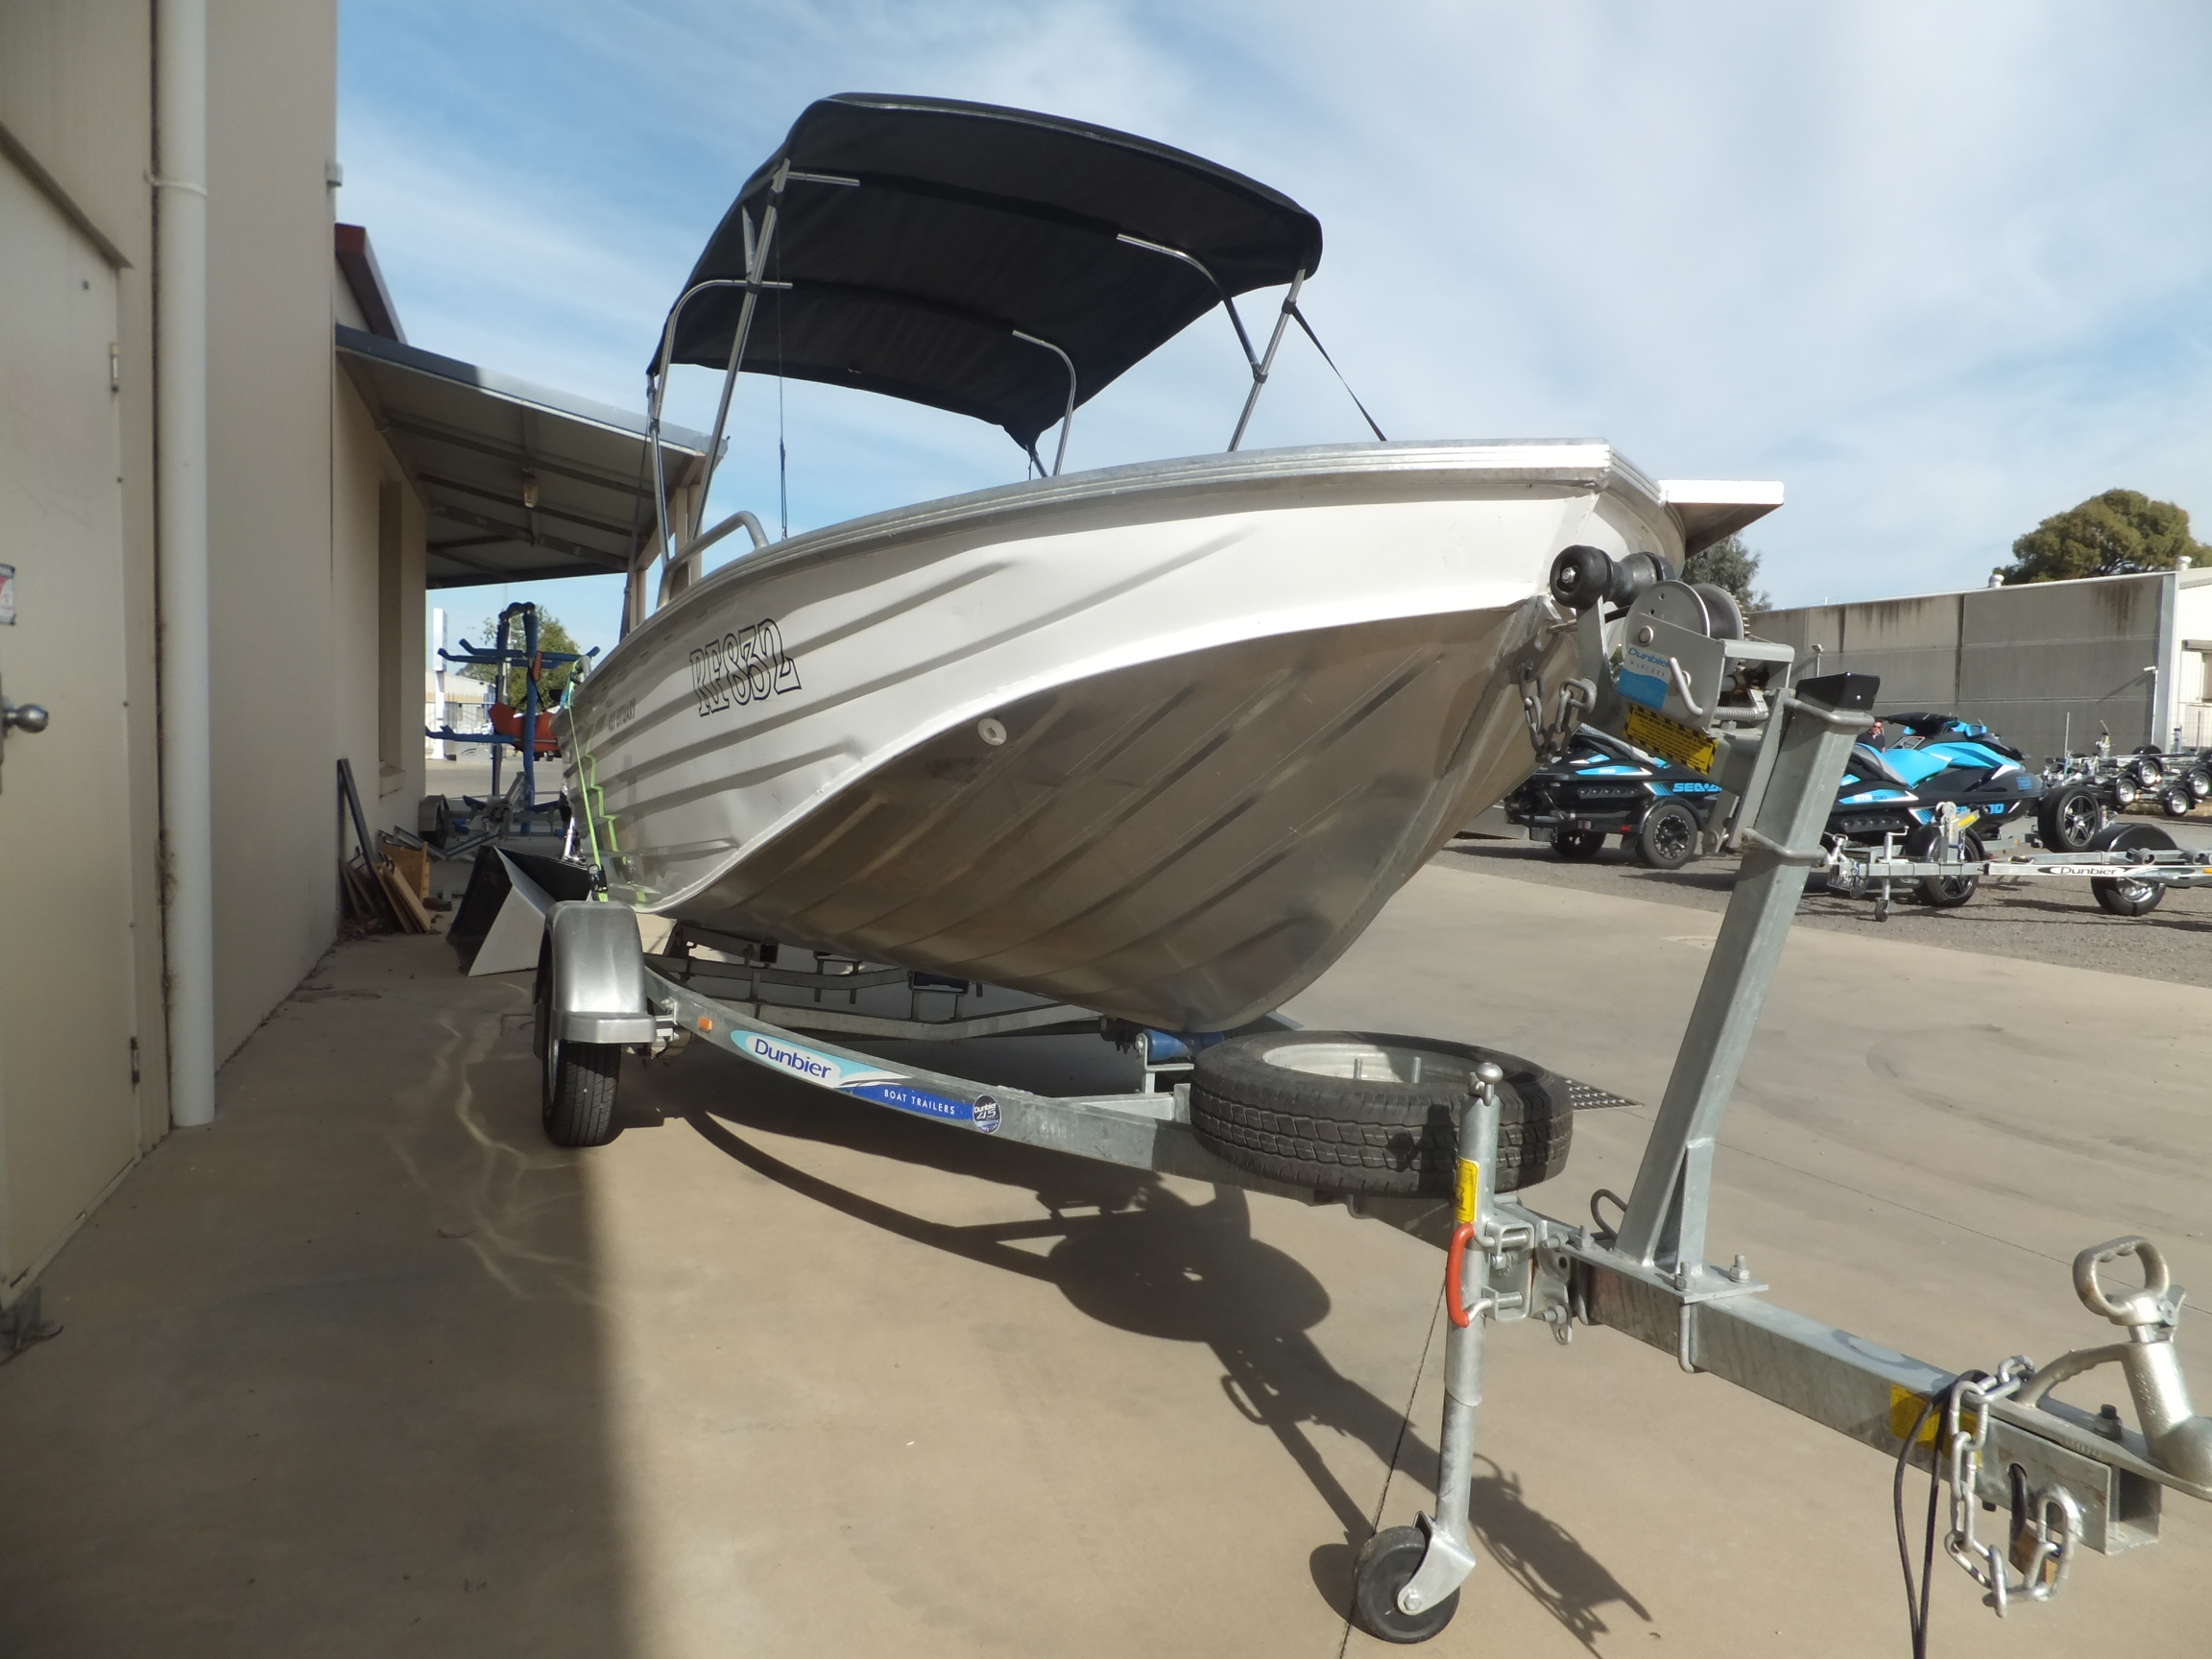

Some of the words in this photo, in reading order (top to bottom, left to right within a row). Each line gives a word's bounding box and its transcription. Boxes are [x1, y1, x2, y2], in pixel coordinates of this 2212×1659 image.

[2059, 866, 2117, 876] Dunbier
[754, 1037, 832, 1080] Dunbier
[884, 1089, 907, 1103] BOAT
[911, 1096, 955, 1116] TRAILERS
